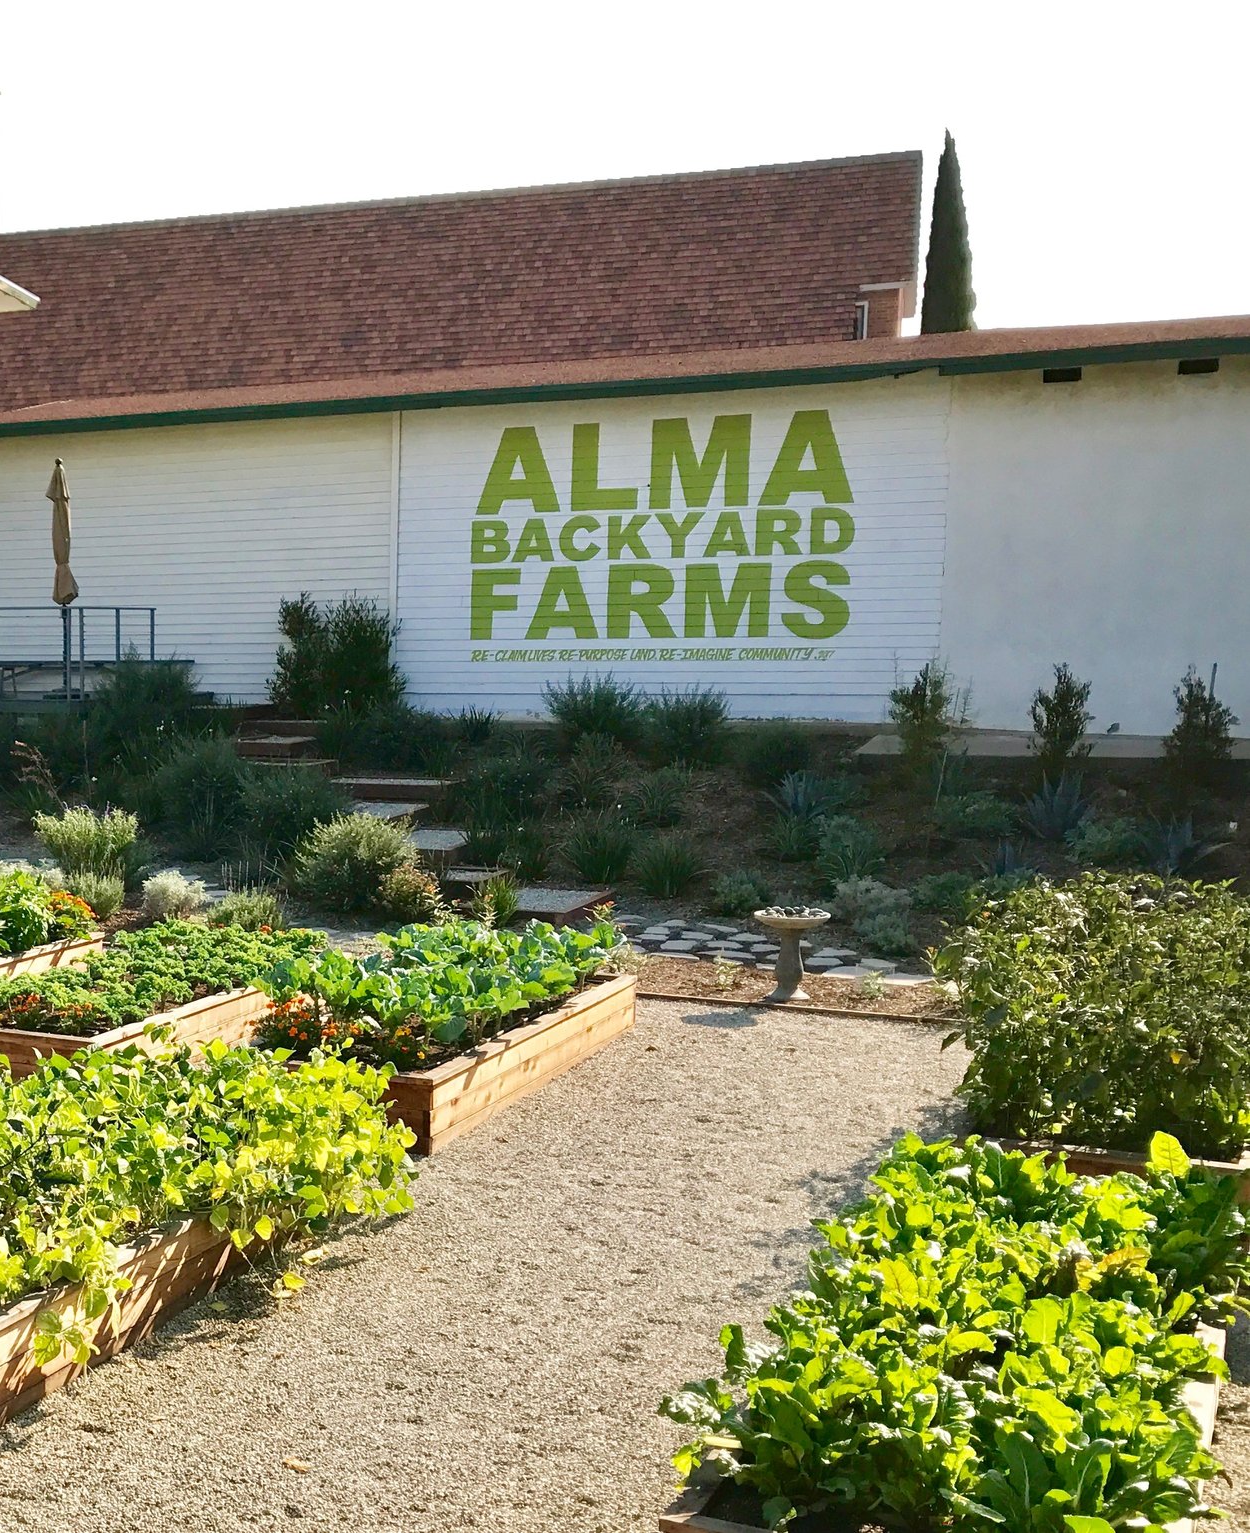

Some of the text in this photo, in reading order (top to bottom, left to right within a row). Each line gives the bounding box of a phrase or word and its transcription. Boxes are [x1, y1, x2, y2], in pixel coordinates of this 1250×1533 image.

[476, 409, 854, 515] ALMA
[470, 507, 856, 564] BACKYARD
[470, 560, 851, 641] FARMS
[658, 648, 736, 661] RE-IMAGINE
